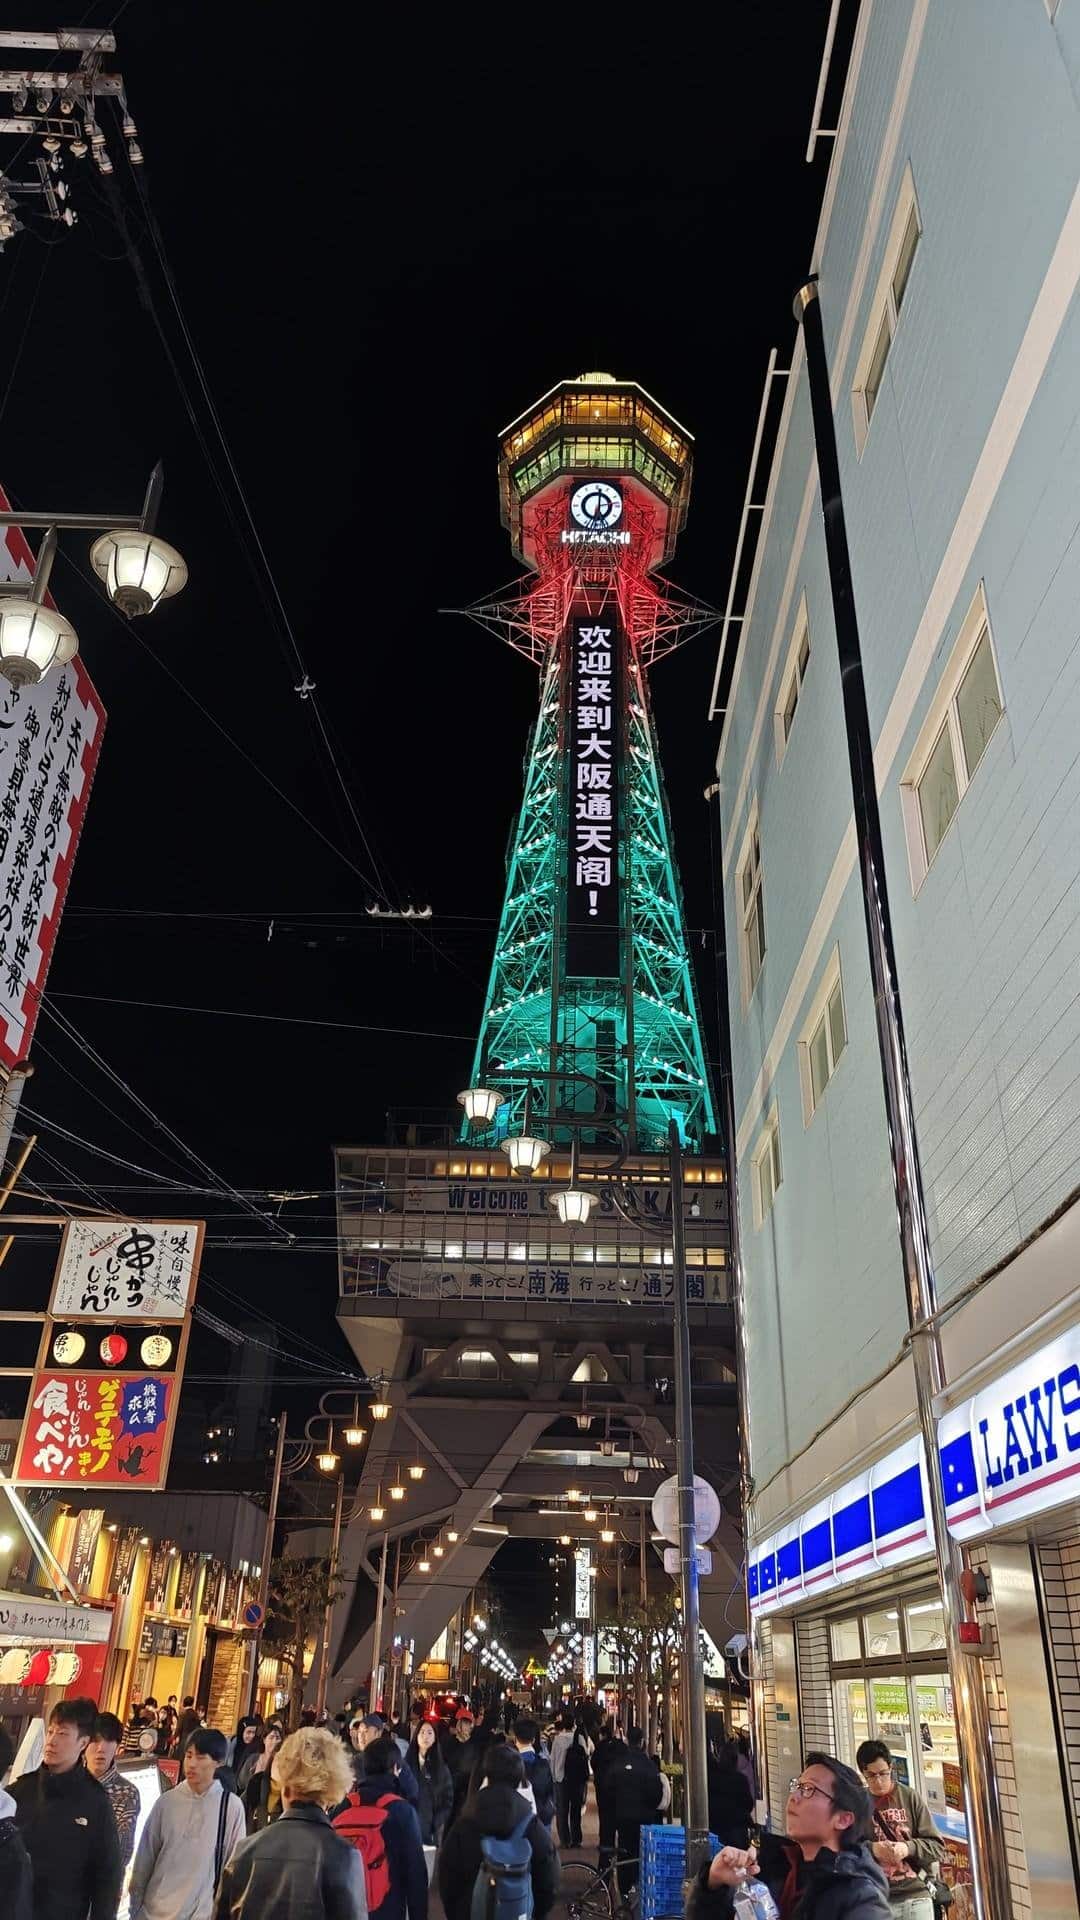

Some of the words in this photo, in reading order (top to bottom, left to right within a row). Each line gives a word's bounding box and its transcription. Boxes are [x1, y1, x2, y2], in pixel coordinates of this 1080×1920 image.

[561, 530, 631, 544] HITACHI
[575, 625, 613, 916] 欢迎来到大阪通天阁！
[448, 1184, 529, 1210] Welcome
[117, 1227, 156, 1308] 串かつ
[469, 1273, 525, 1289] 乗ってこ!
[528, 1268, 570, 1295] 南海
[579, 1275, 637, 1293] 行っとこ!
[32, 1378, 73, 1476] 食べや！
[90, 1378, 121, 1473] ゲテモノ
[978, 1363, 1080, 1488] LAWS
